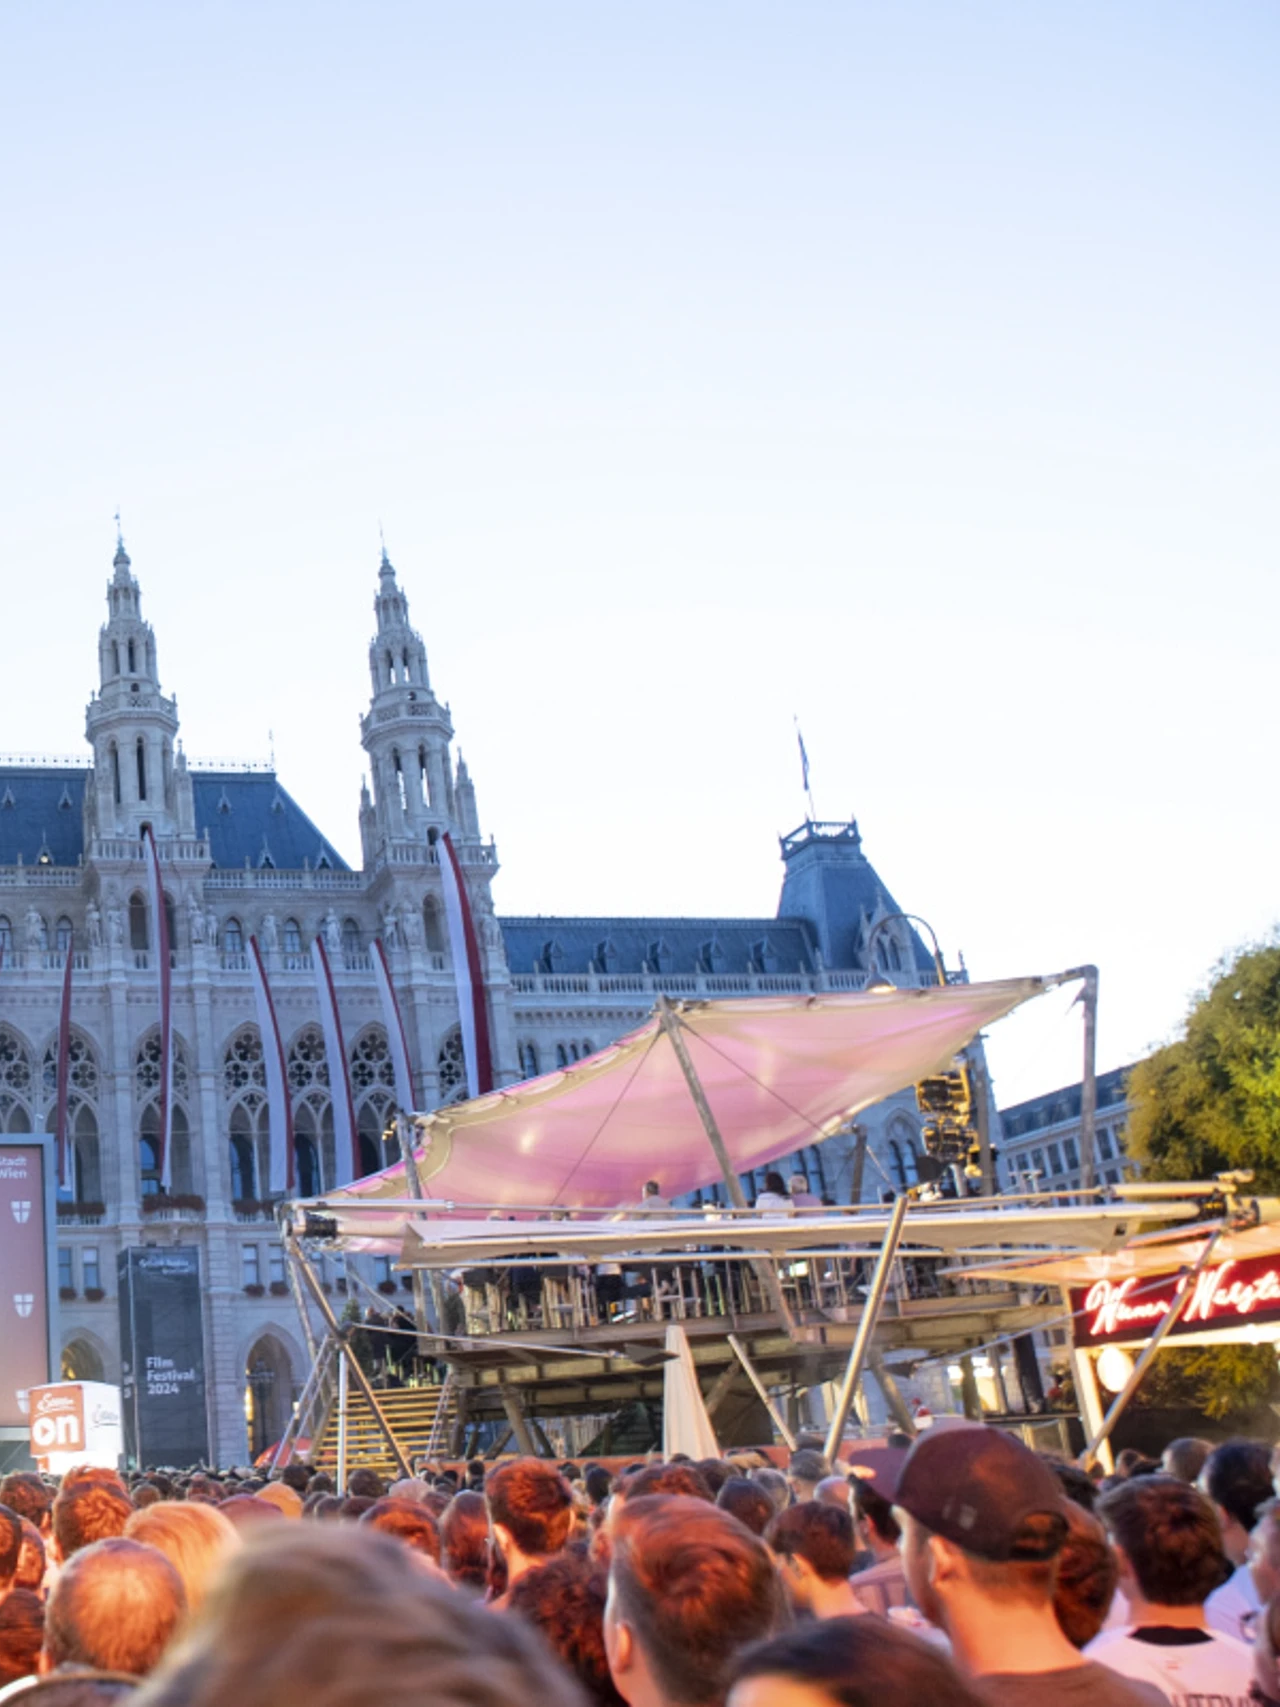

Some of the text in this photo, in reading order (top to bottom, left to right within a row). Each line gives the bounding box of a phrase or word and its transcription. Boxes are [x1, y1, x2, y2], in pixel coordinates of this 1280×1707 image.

[146, 1356, 174, 1369] Film
[147, 1368, 196, 1382] Festival
[147, 1382, 179, 1395] 2024
